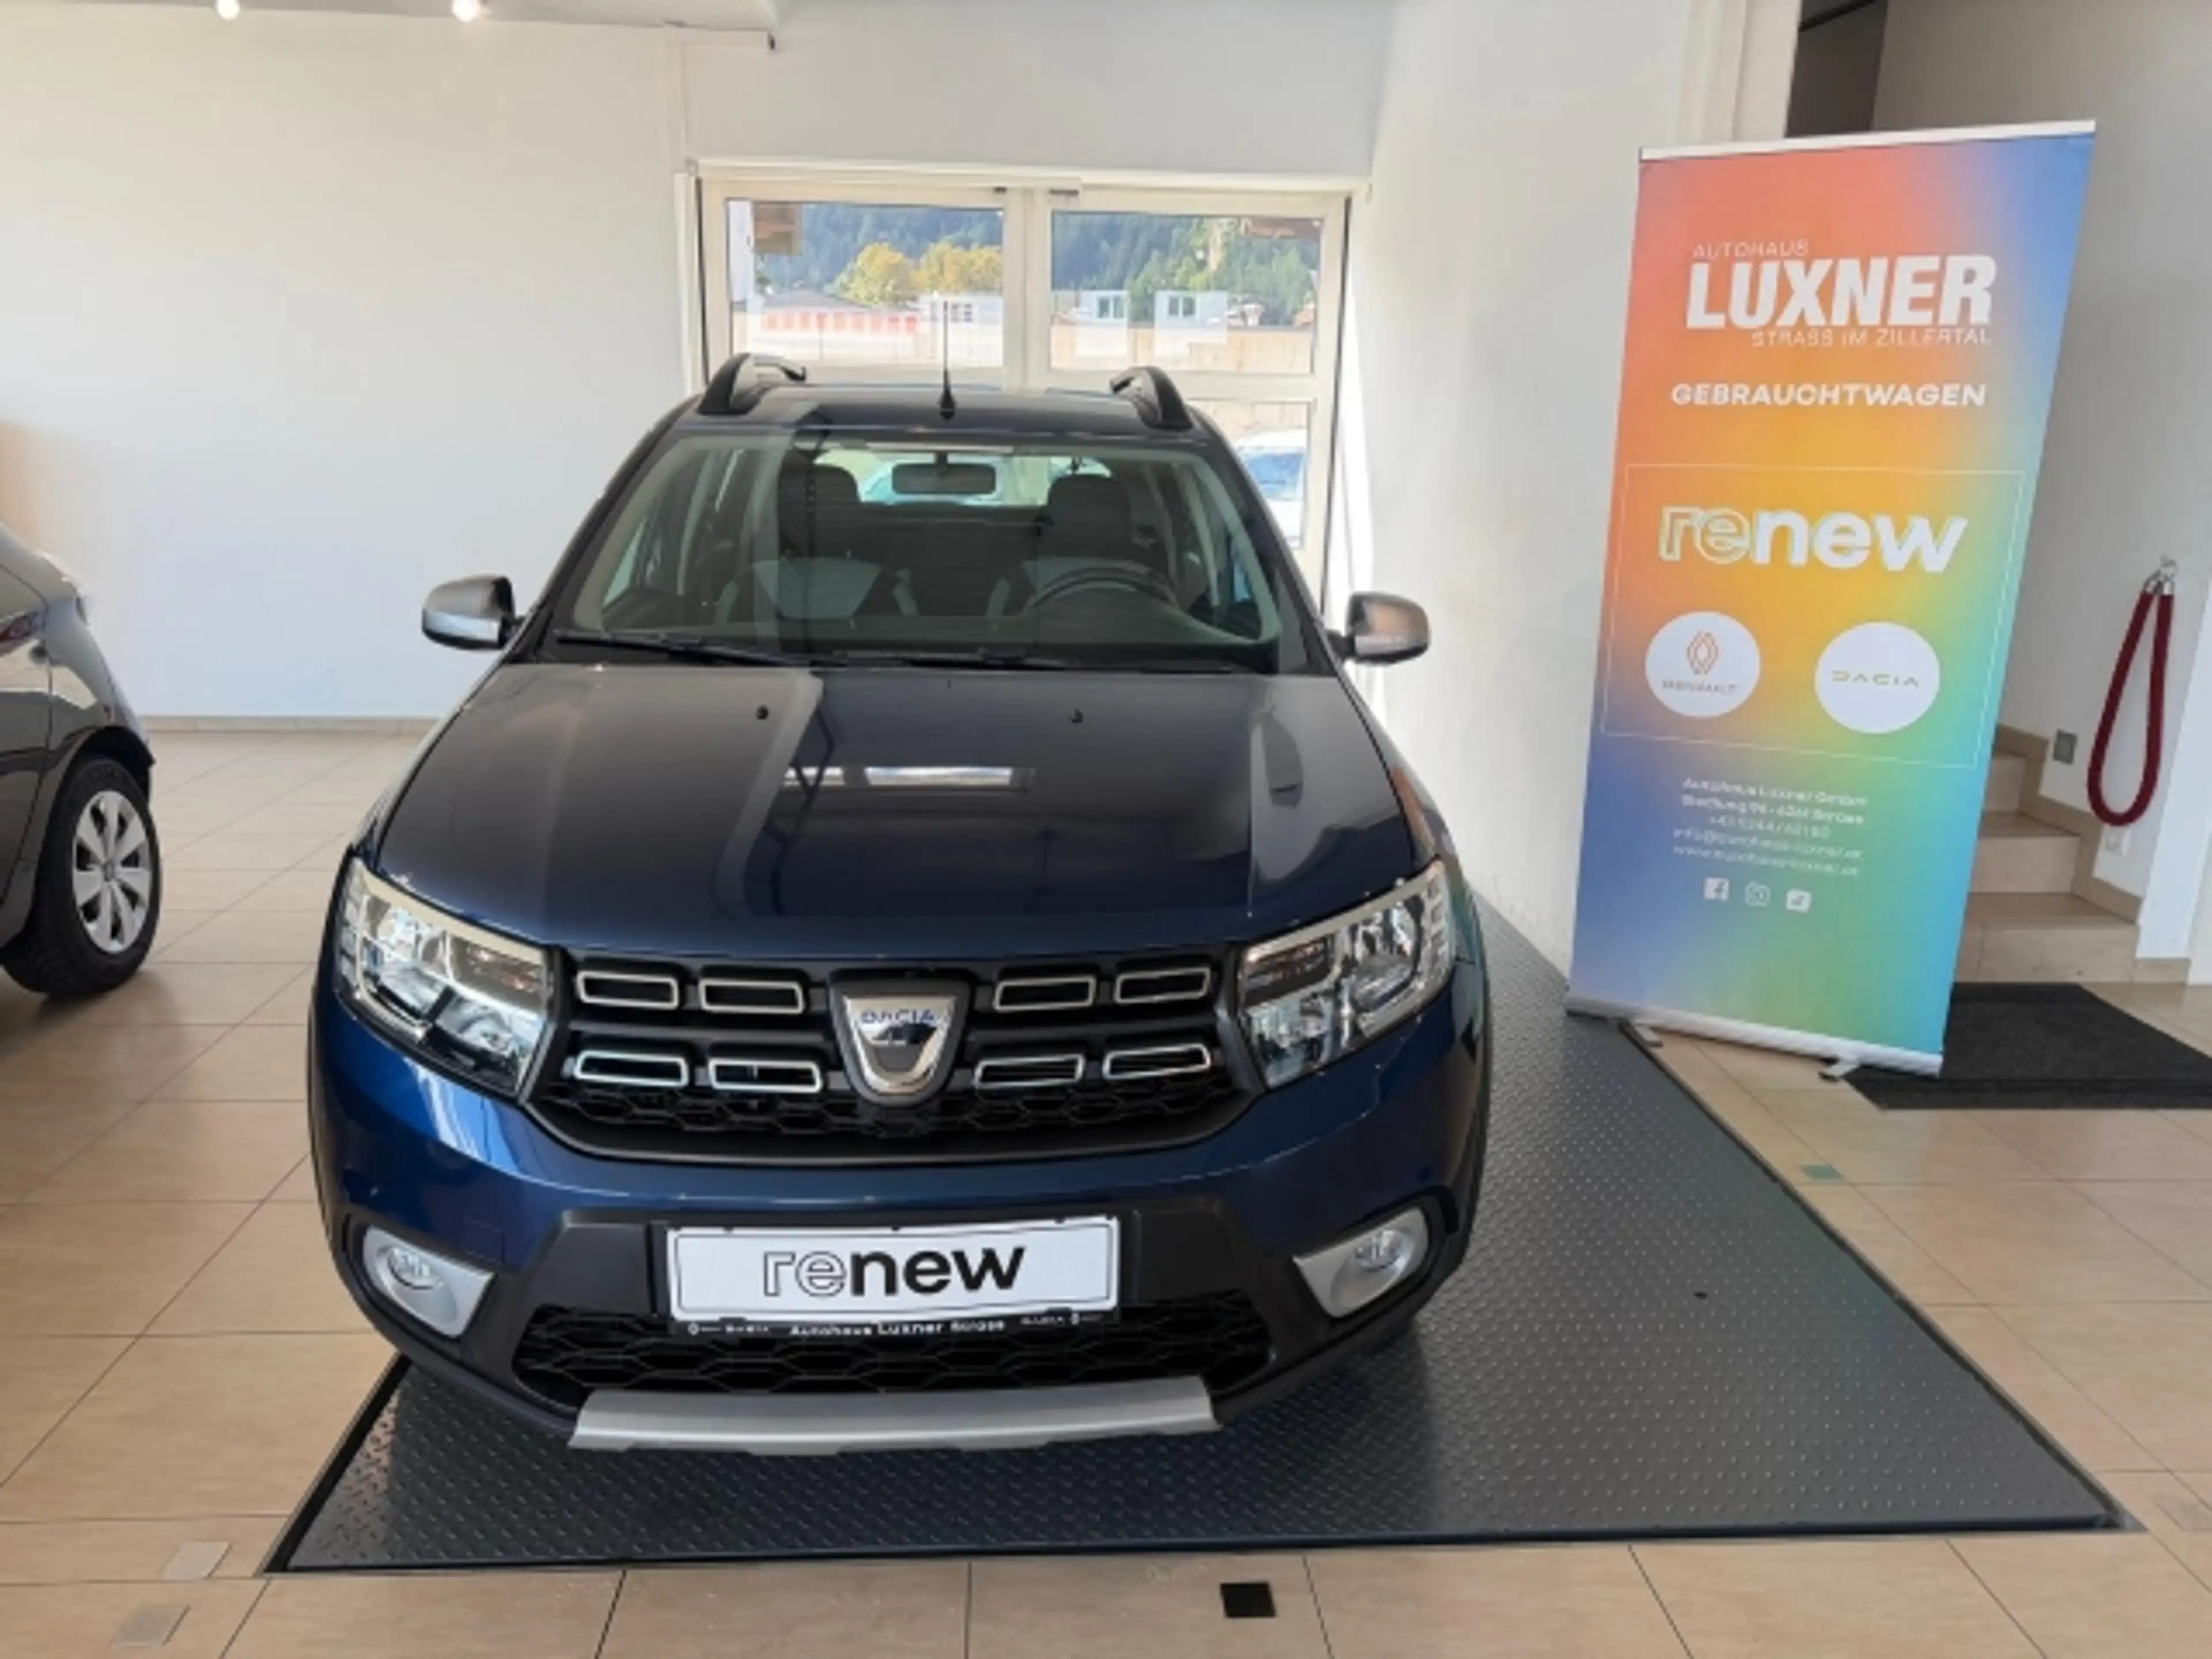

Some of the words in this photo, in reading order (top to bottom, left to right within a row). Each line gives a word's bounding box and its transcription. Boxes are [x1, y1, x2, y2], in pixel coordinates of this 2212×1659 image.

[1692, 238, 1809, 259] AUTOHAUS
[1685, 255, 1997, 329] LUXNER
[1752, 330, 1833, 347] STRASS
[1843, 330, 1868, 346] IM
[1876, 328, 1992, 346] ZILLERTAL
[1671, 382, 1986, 407] GEBRAUCHTWAGEN
[1658, 505, 1969, 573] renew
[1832, 669, 1919, 689] DACIA
[862, 1009, 935, 1024] DACIA
[763, 1245, 1026, 1296] renew
[877, 1321, 942, 1335] Luxner
